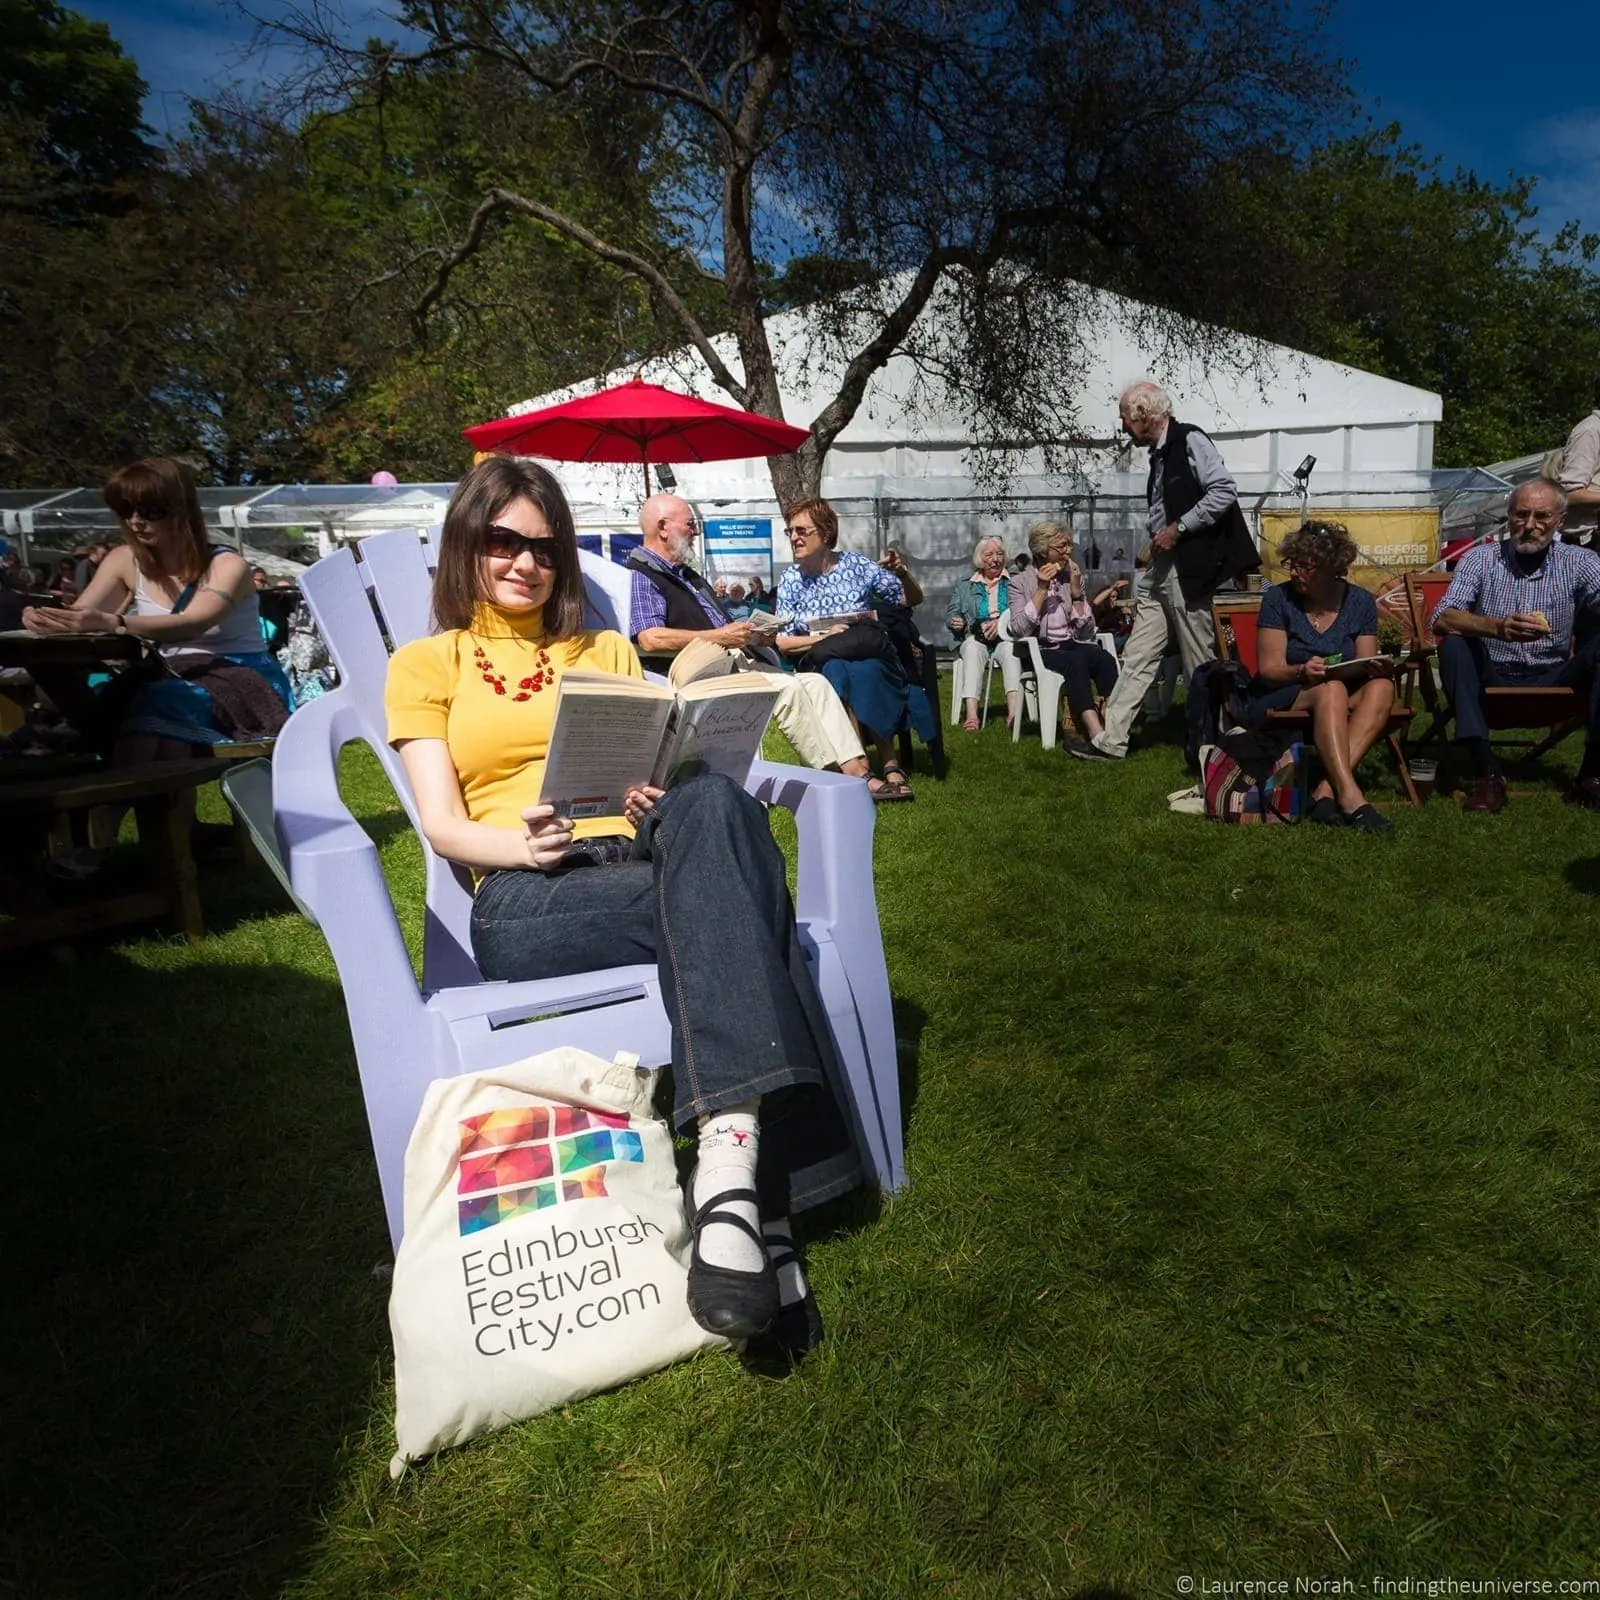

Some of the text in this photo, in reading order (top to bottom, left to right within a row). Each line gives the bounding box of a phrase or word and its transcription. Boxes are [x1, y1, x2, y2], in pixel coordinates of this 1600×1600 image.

[1371, 553, 1428, 565] THEATRE
[1374, 544, 1428, 555] GIFFORD
[462, 1215, 664, 1287] Edinburgh
[467, 1245, 621, 1325] Festival
[475, 1283, 660, 1356] City.com
